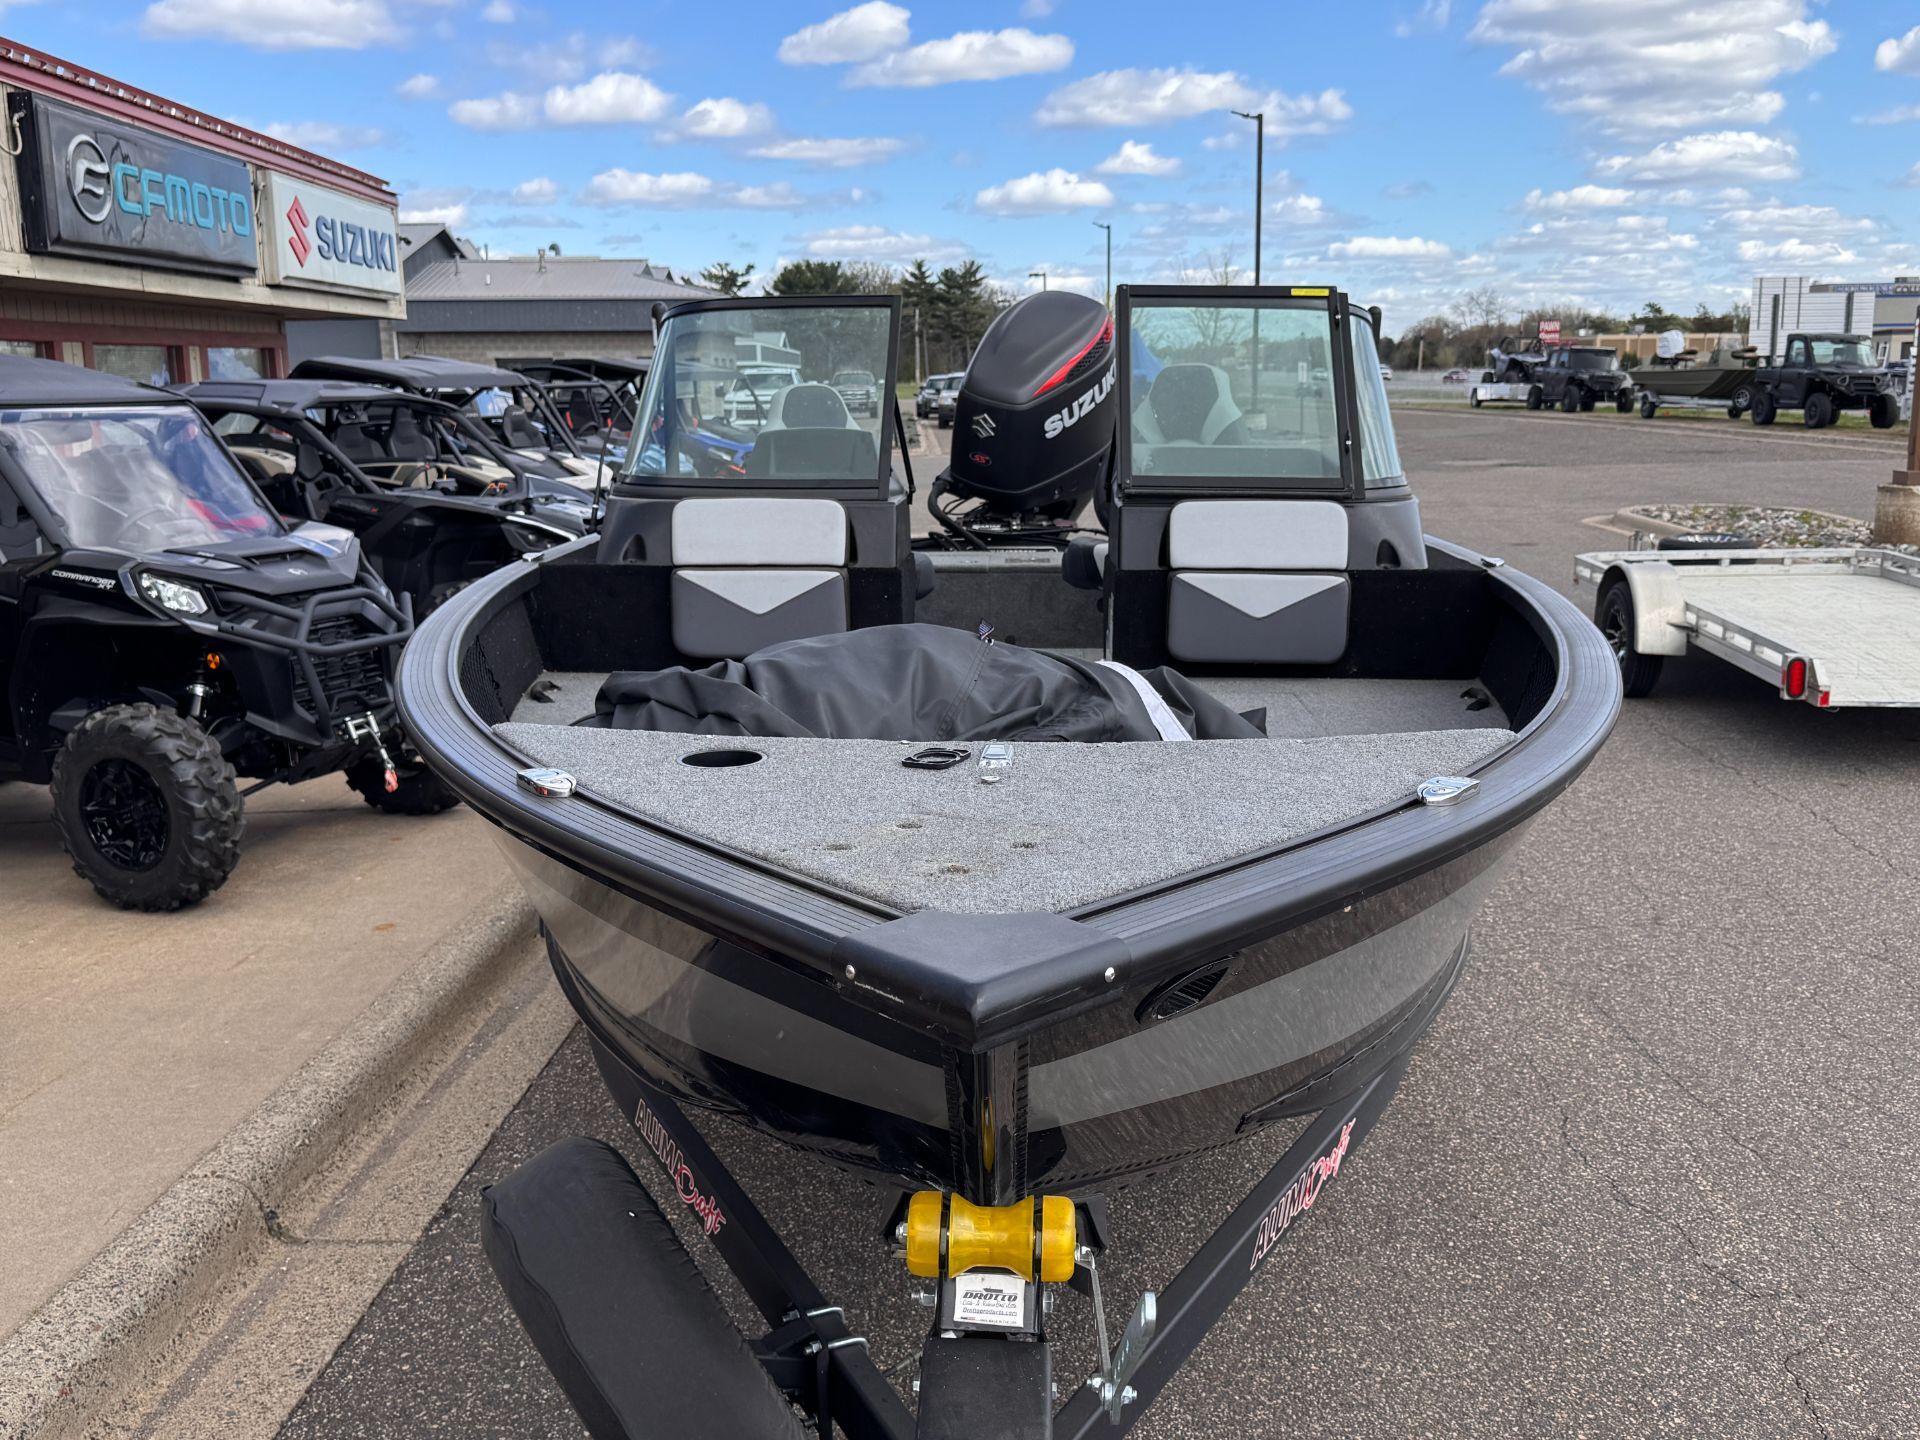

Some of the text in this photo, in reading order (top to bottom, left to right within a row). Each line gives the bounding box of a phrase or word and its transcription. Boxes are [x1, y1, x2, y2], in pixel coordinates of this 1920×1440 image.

[115, 162, 251, 237] CFMOTO
[316, 215, 397, 273] SUZUKI
[51, 569, 116, 586] COMMANDER
[962, 1291, 1018, 1302] DROTTO
